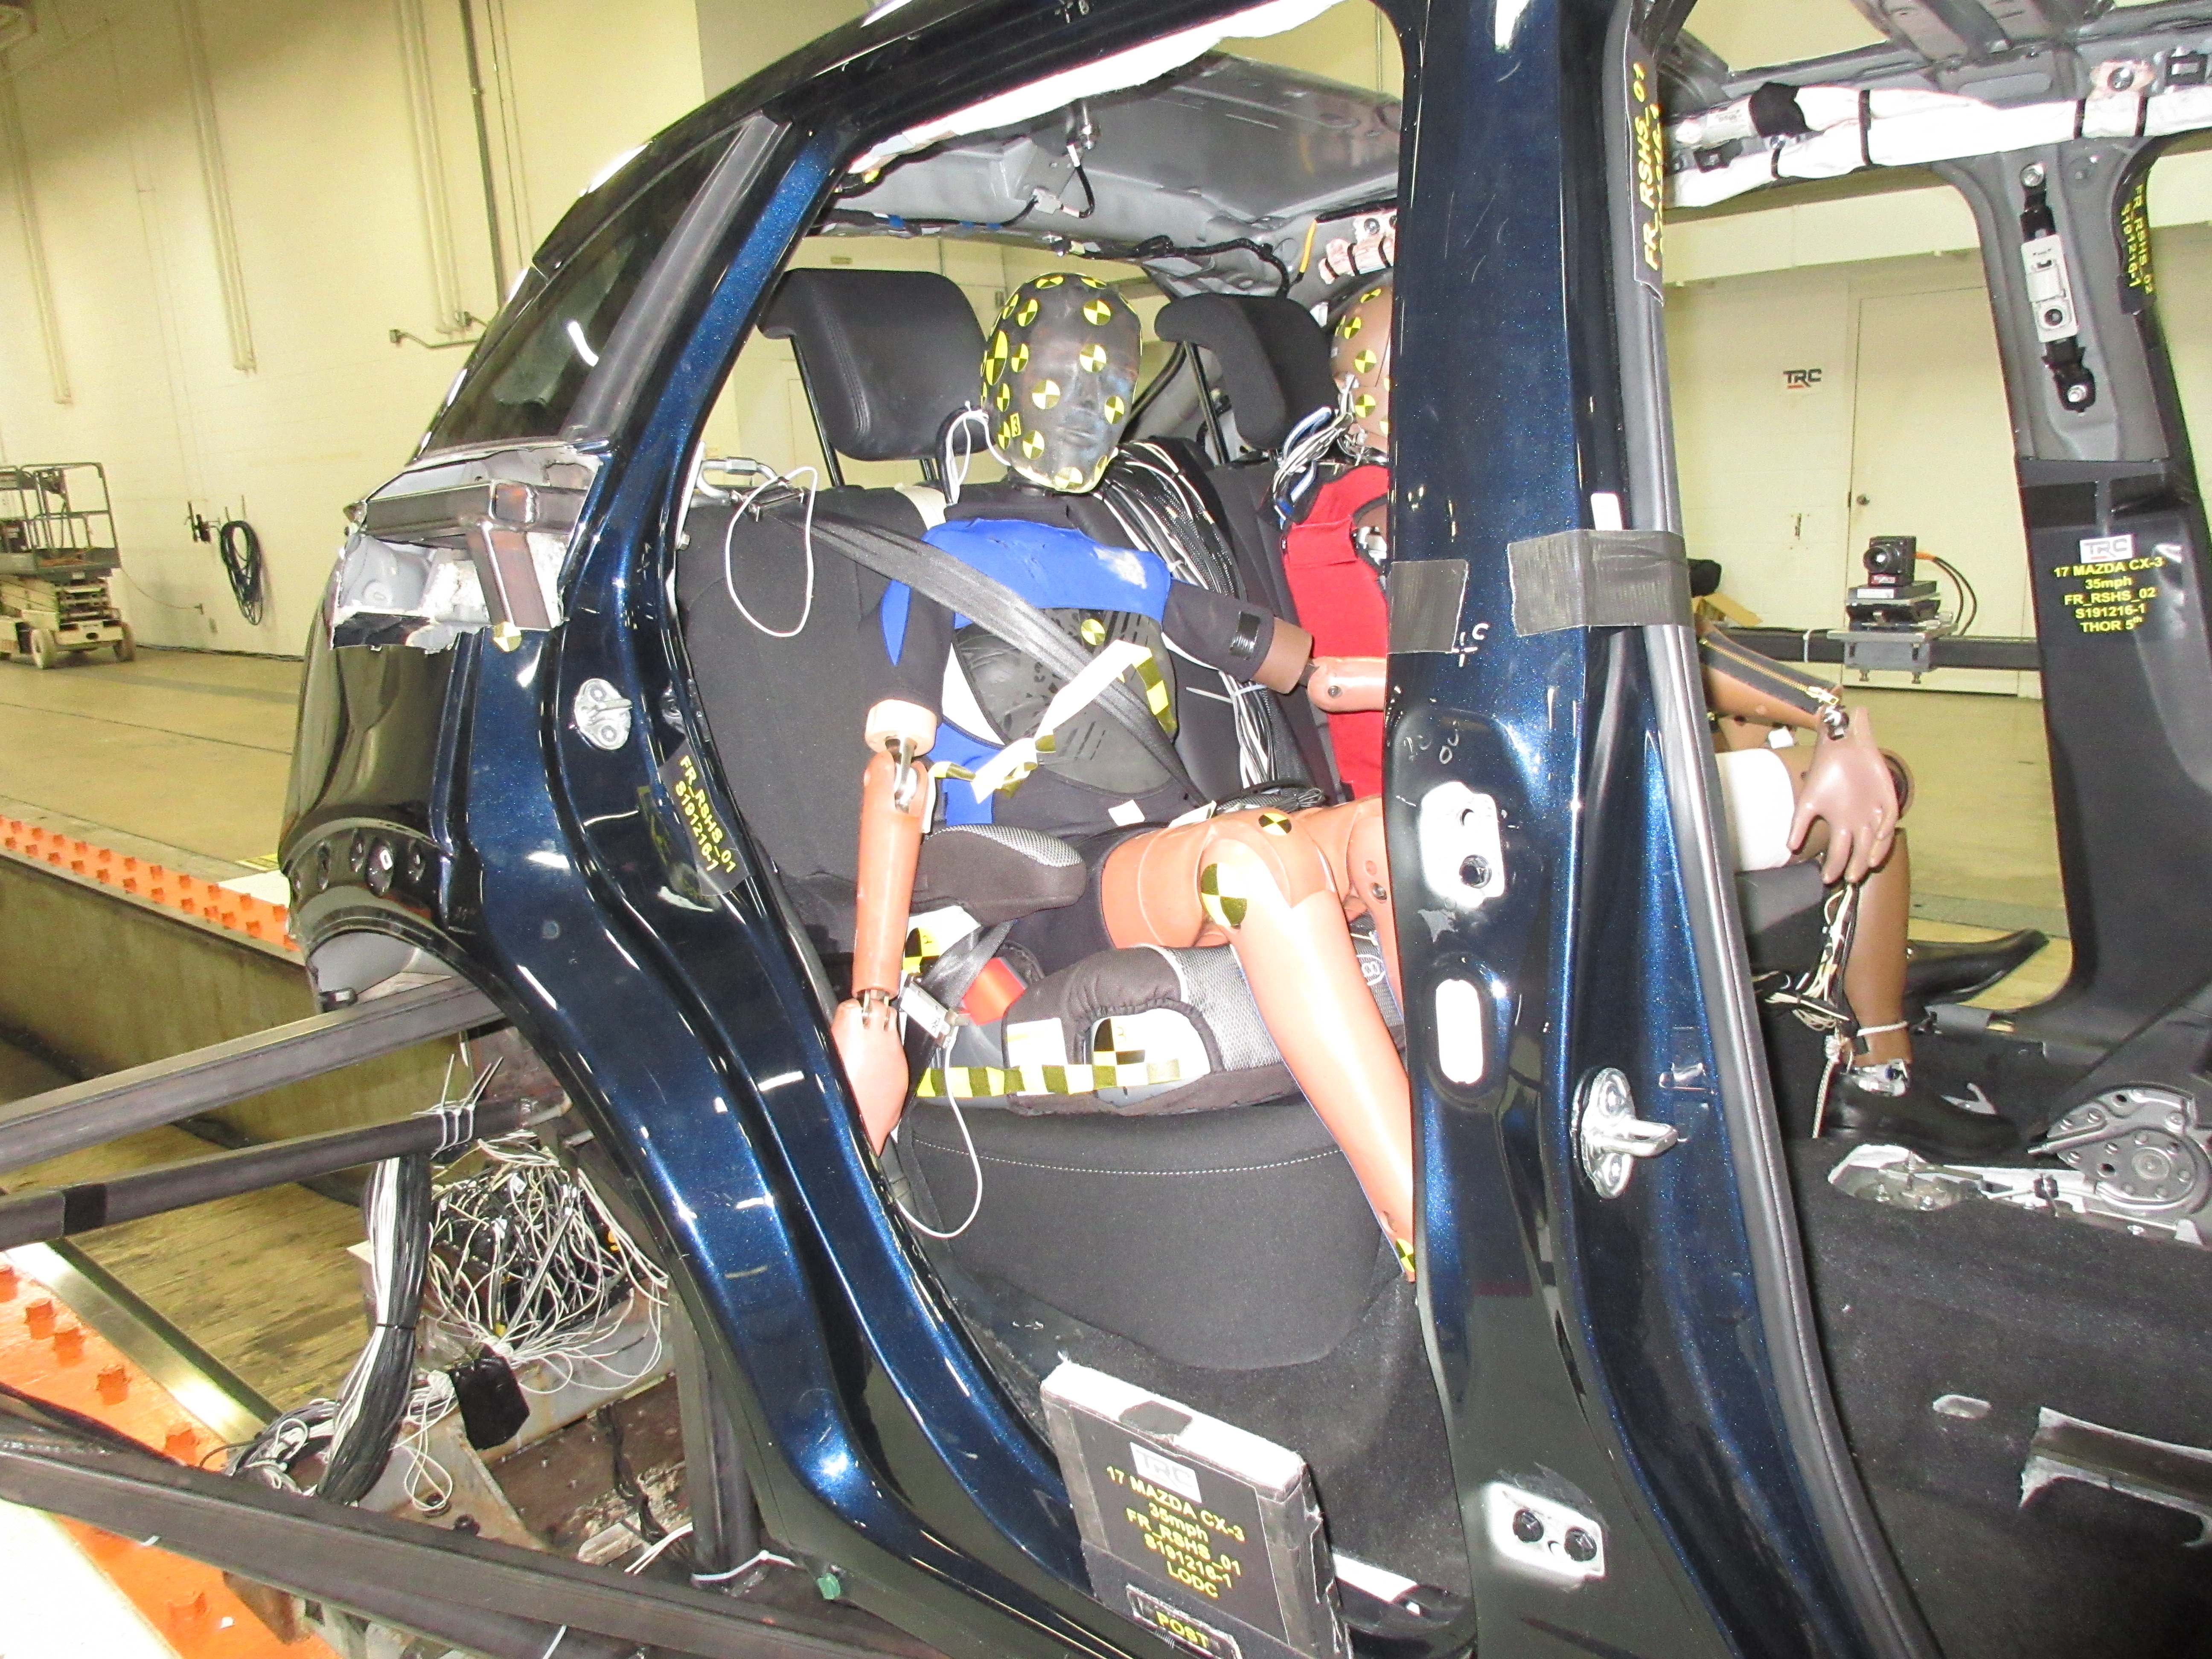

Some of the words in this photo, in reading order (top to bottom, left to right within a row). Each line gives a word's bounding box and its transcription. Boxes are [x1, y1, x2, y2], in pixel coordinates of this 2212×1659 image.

[1783, 369, 1822, 387] TRC
[1013, 416, 1019, 435] 3
[2053, 566, 2070, 577] 17
[2073, 562, 2125, 576] MAZDA
[2129, 556, 2165, 571] CX-3
[2084, 538, 2128, 558] TRC
[2064, 587, 2157, 606] FR_RSHS_02
[2085, 576, 2133, 590] 35mph
[2075, 603, 2146, 619] S191216-1
[2081, 619, 2122, 632] THOR
[675, 780, 719, 871] S191216-1
[680, 755, 736, 873] FR_RSHS_01
[1135, 1449, 1193, 1489] TRC
[1106, 1466, 1125, 1484] 17
[1130, 1476, 1197, 1519] MAZDA
[1200, 1510, 1245, 1542] CX-3
[1149, 1502, 1209, 1543] 35mph
[1126, 1508, 1241, 1576] FR_RSHS_01
[1144, 1533, 1232, 1589] S191216-1
[1167, 1560, 1219, 1598] LODC
[1155, 1610, 1209, 1648] POST
